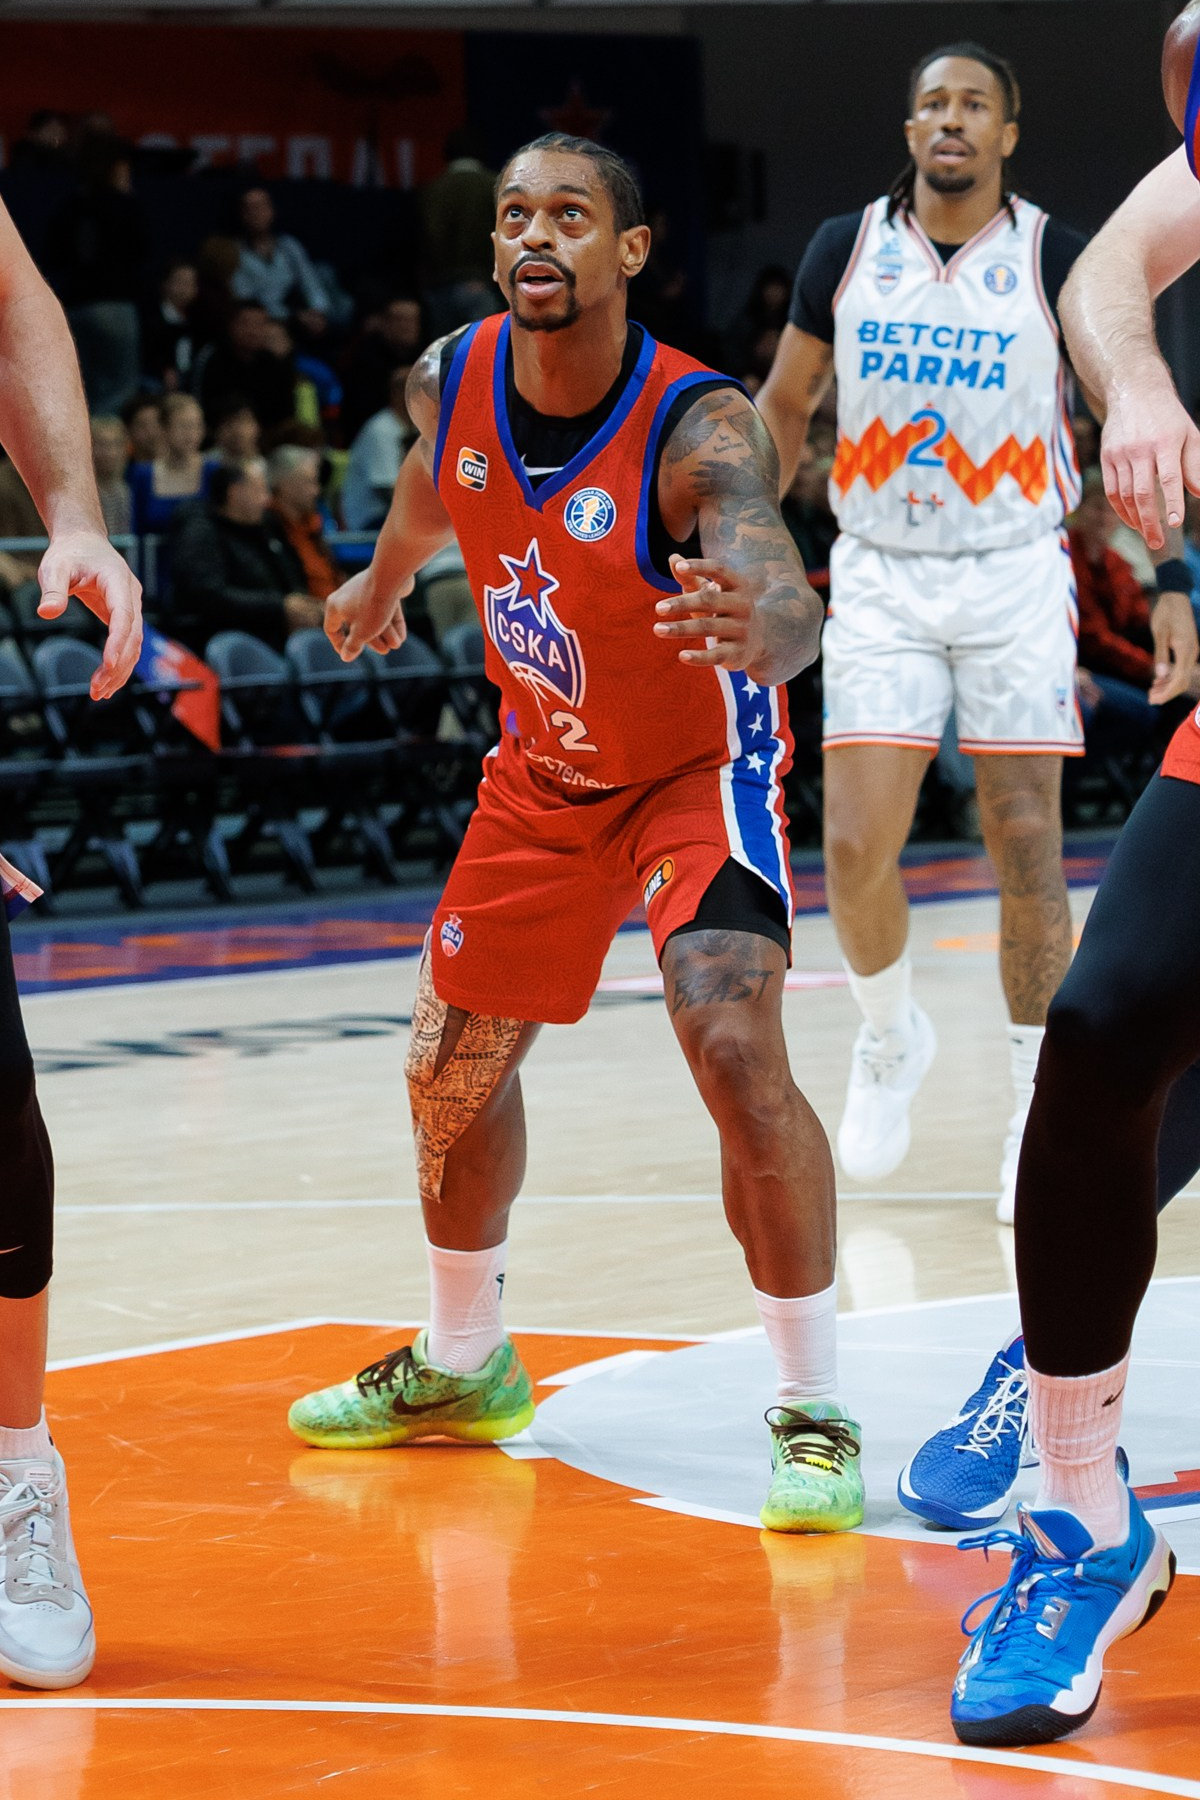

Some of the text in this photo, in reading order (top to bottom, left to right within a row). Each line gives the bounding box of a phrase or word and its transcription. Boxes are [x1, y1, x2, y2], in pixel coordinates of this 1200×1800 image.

[857, 320, 1018, 354] BETCITY
[860, 351, 1007, 390] PARMA
[905, 408, 947, 467] 2
[464, 462, 485, 479] WIN
[497, 611, 566, 673] CSKA
[550, 709, 600, 753] 2
